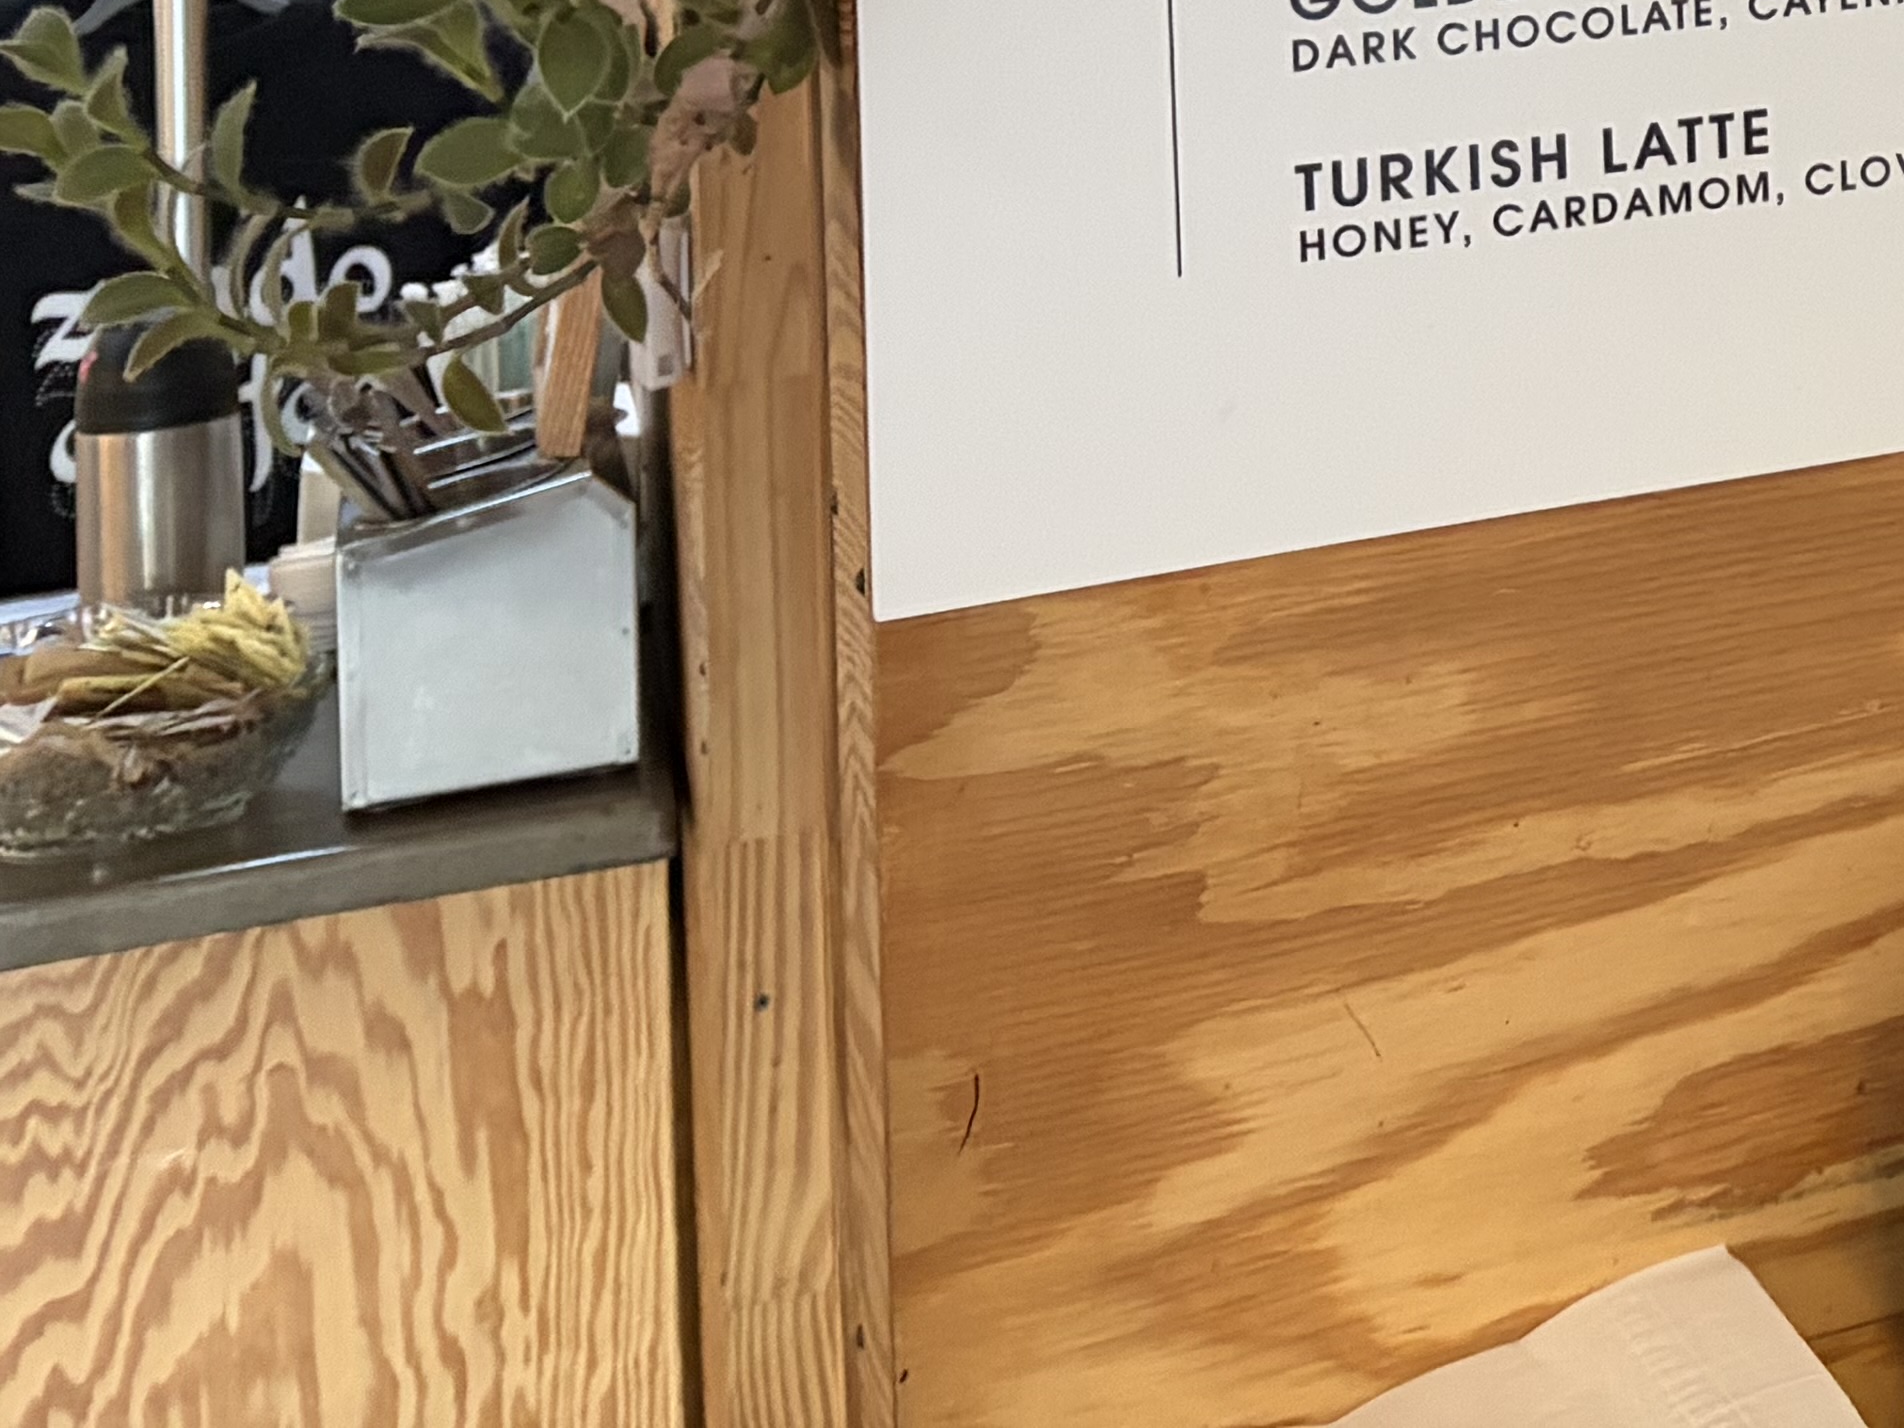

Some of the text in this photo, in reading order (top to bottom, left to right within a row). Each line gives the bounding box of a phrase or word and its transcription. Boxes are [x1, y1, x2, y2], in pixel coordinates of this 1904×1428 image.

[1292, 106, 1771, 213] TURKISH LATTE
[1298, 209, 1474, 264] HONEY,
[1491, 169, 1785, 239] CARDAMOM,
